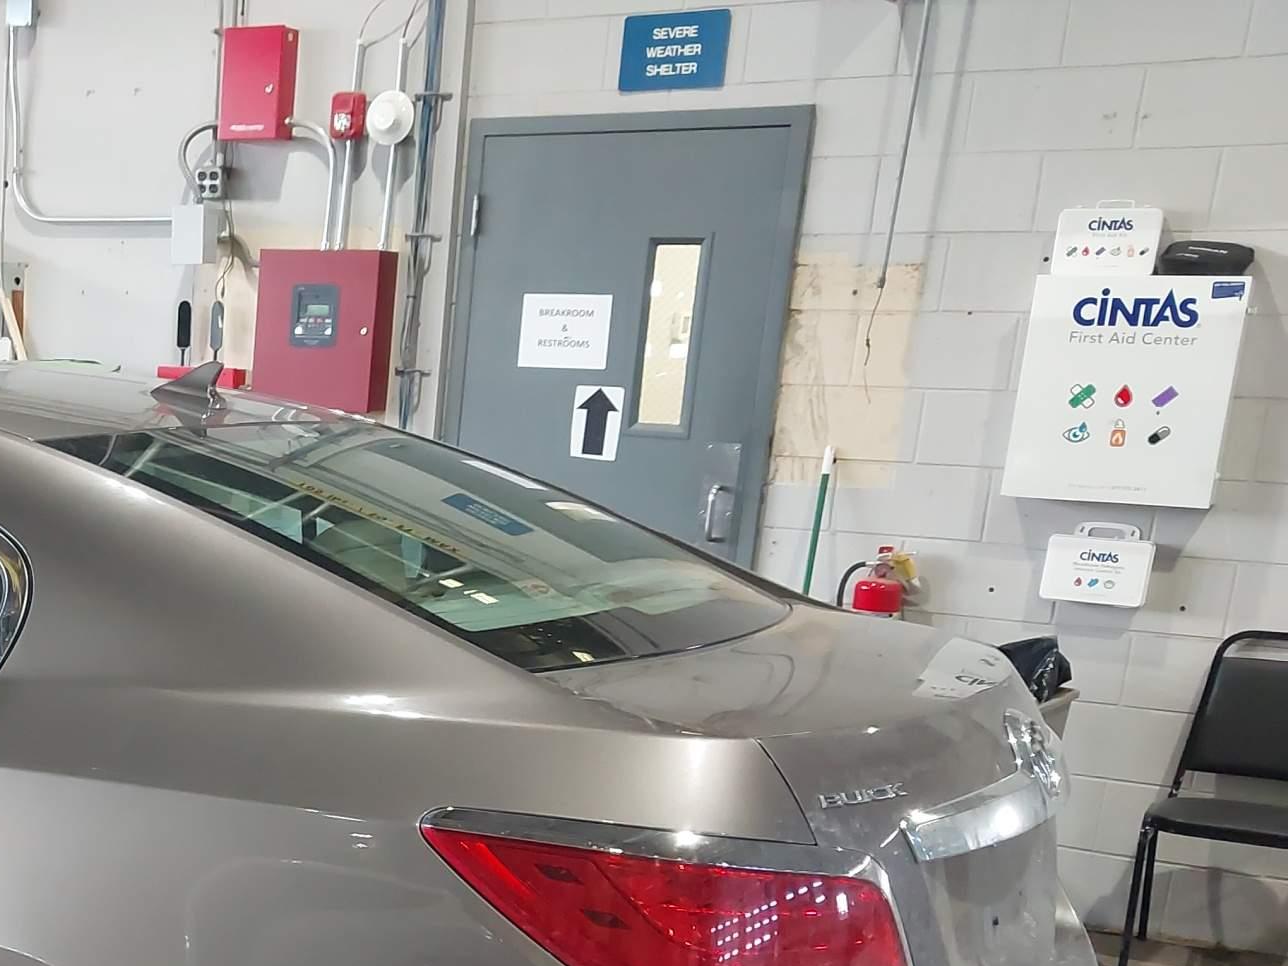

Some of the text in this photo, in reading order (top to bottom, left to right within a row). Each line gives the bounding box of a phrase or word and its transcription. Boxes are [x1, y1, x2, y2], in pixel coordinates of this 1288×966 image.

[652, 25, 699, 40] SEVERE
[646, 43, 702, 58] WEATHER
[645, 62, 698, 76] SHELTER
[538, 307, 595, 317] BREAKROOM
[561, 324, 568, 333] &
[537, 338, 591, 348] RESTROOMS
[1069, 331, 1198, 346] First Aid Center
[818, 782, 908, 809] BUICK
